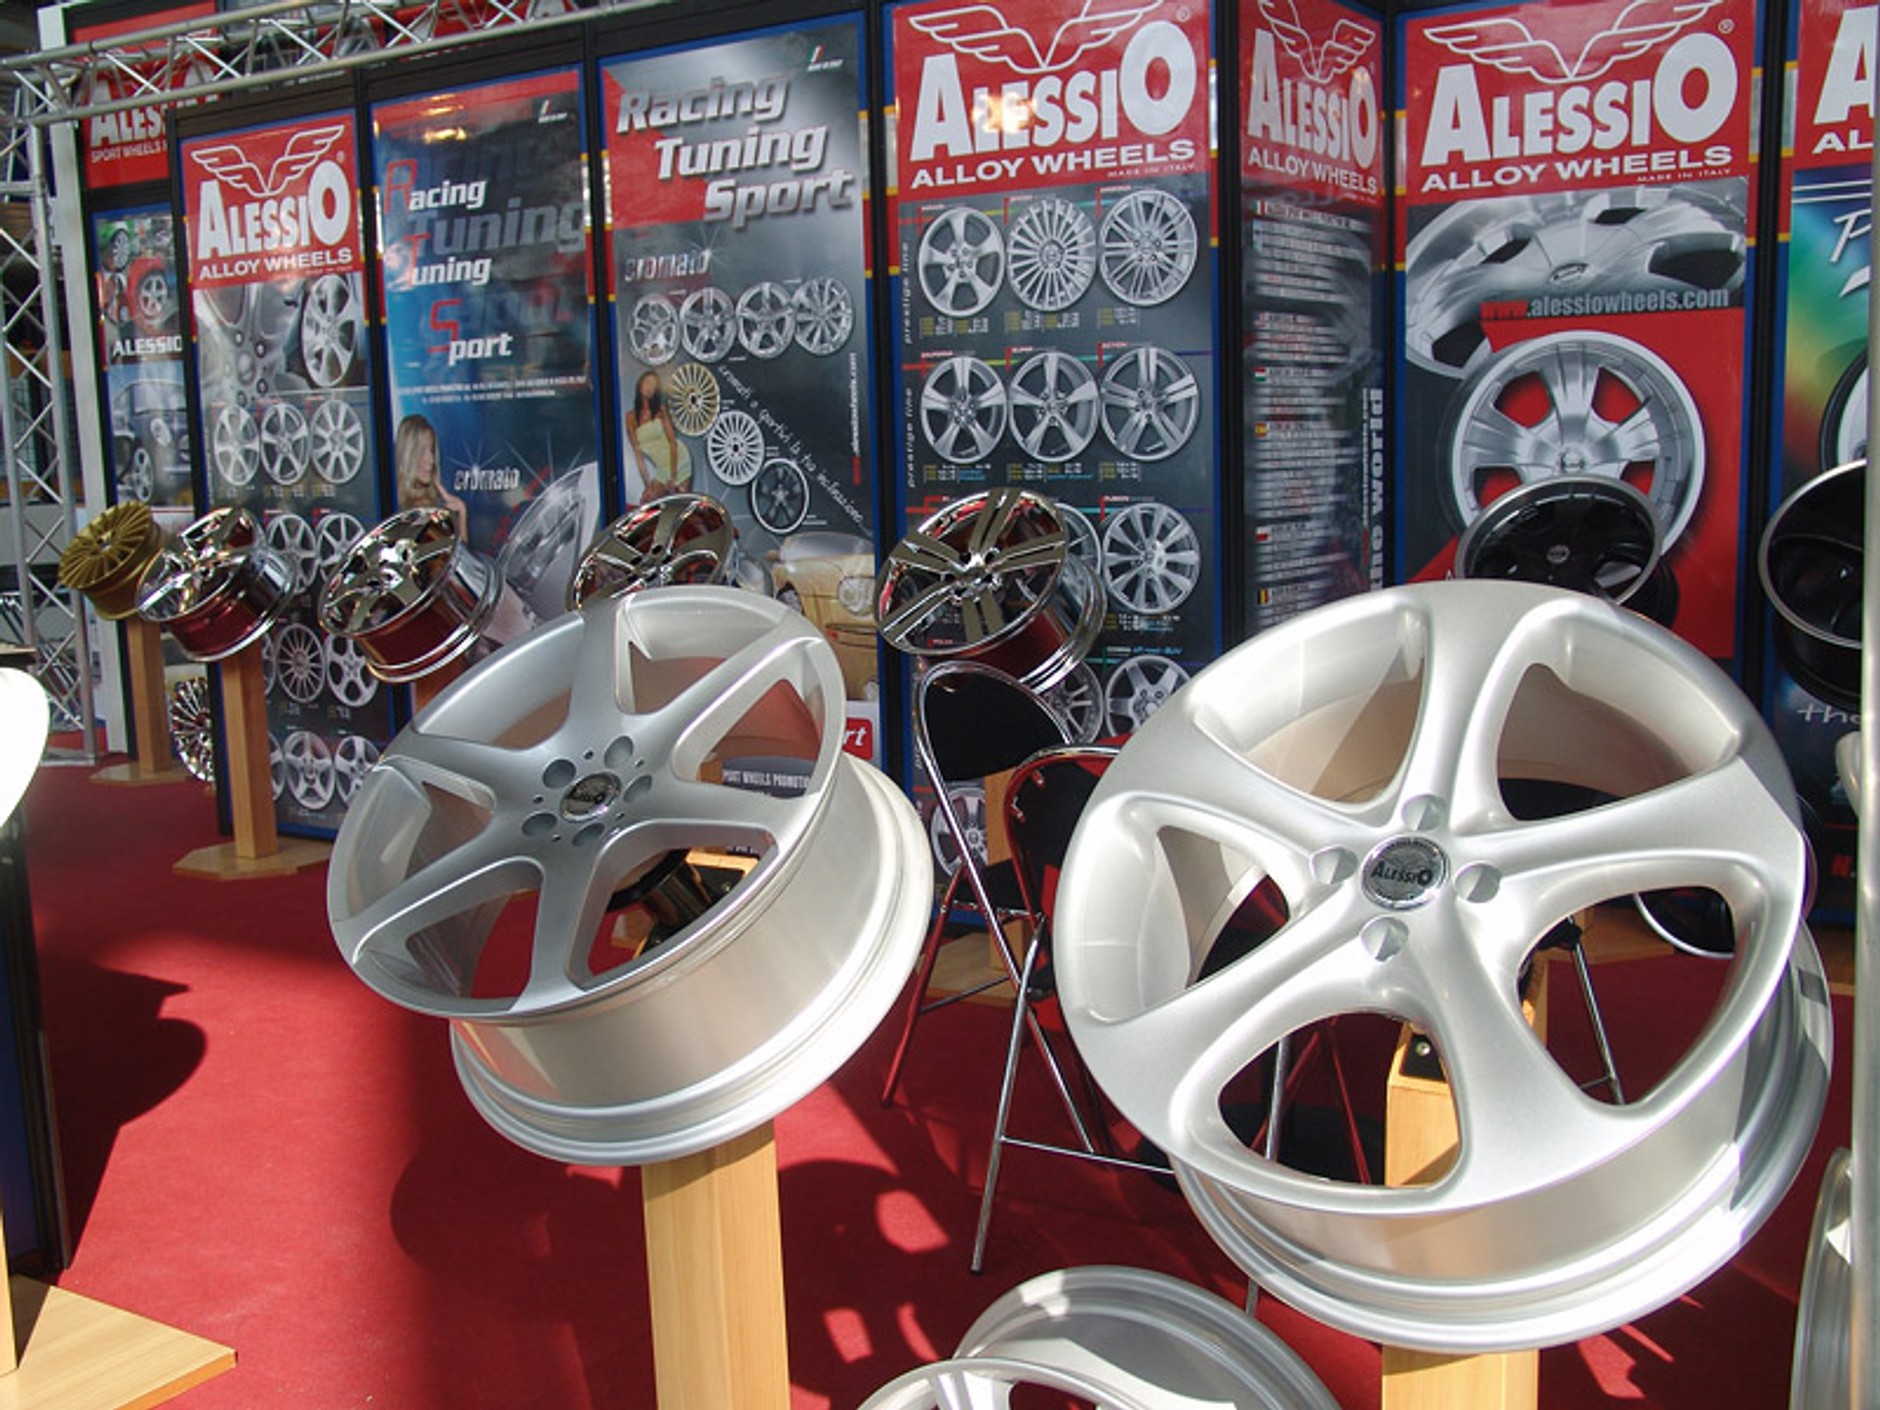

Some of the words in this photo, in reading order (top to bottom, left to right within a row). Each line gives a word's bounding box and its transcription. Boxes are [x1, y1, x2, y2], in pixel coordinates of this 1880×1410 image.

[616, 75, 790, 133] Racing
[909, 20, 1197, 162] ALESSIO
[1248, 28, 1377, 169] ALESSIO
[1420, 32, 1738, 167] ALESSIO
[655, 125, 828, 181] Tuning
[911, 157, 1024, 189] ALLOY
[1032, 139, 1196, 175] WHEELS
[1248, 147, 1309, 178] ALLOY
[1312, 161, 1378, 195] WHEELS
[1421, 162, 1548, 193] ALLOY
[1555, 146, 1734, 180] WHEELS
[1637, 173, 1672, 183] MADE
[1677, 171, 1693, 179] IN
[1698, 168, 1732, 177] ITALY
[197, 159, 350, 260] ALESSIO
[384, 158, 487, 215] Racing
[703, 168, 855, 231] Sport
[199, 260, 260, 281] ALLOY
[265, 247, 353, 271] WHEELS
[403, 232, 491, 287] Tuning
[428, 297, 514, 367] Sport
[1370, 860, 1433, 887] ALESSIO
